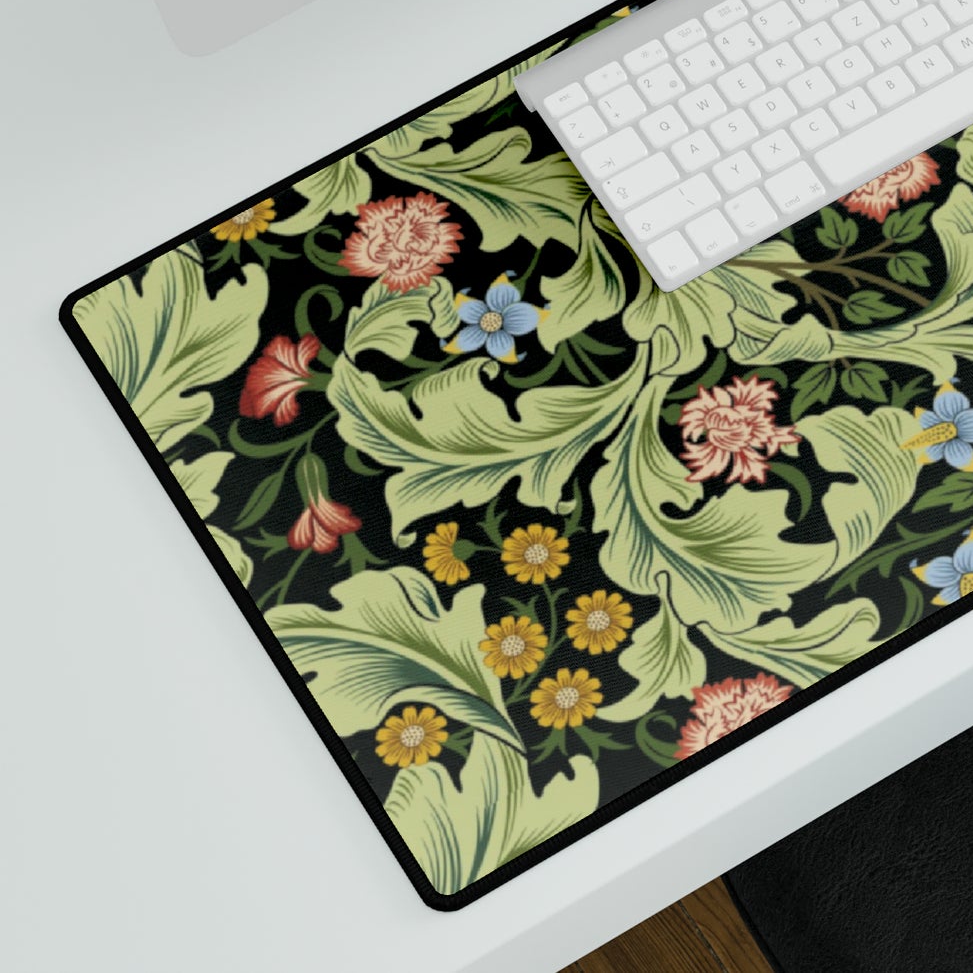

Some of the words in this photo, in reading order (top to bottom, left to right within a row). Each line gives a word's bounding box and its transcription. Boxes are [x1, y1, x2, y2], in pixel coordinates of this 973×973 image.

[642, 78, 654, 89] 2
[681, 57, 692, 68] 3
[719, 36, 731, 46] 4
[758, 15, 768, 28] 5
[658, 120, 673, 132] Q
[694, 98, 711, 112] W
[736, 78, 748, 90] E
[775, 58, 788, 69] R
[812, 35, 824, 47] T
[850, 15, 864, 27] Z
[687, 140, 701, 155] A
[727, 121, 738, 134] S
[764, 99, 777, 114] D
[804, 78, 814, 91] F
[842, 58, 856, 70] G
[879, 36, 893, 51] H
[920, 16, 929, 28] J
[729, 162, 741, 176] Y
[768, 141, 783, 156] X
[807, 120, 820, 132] C
[845, 98, 857, 111] V
[884, 79, 896, 91] B
[922, 57, 936, 70] N
